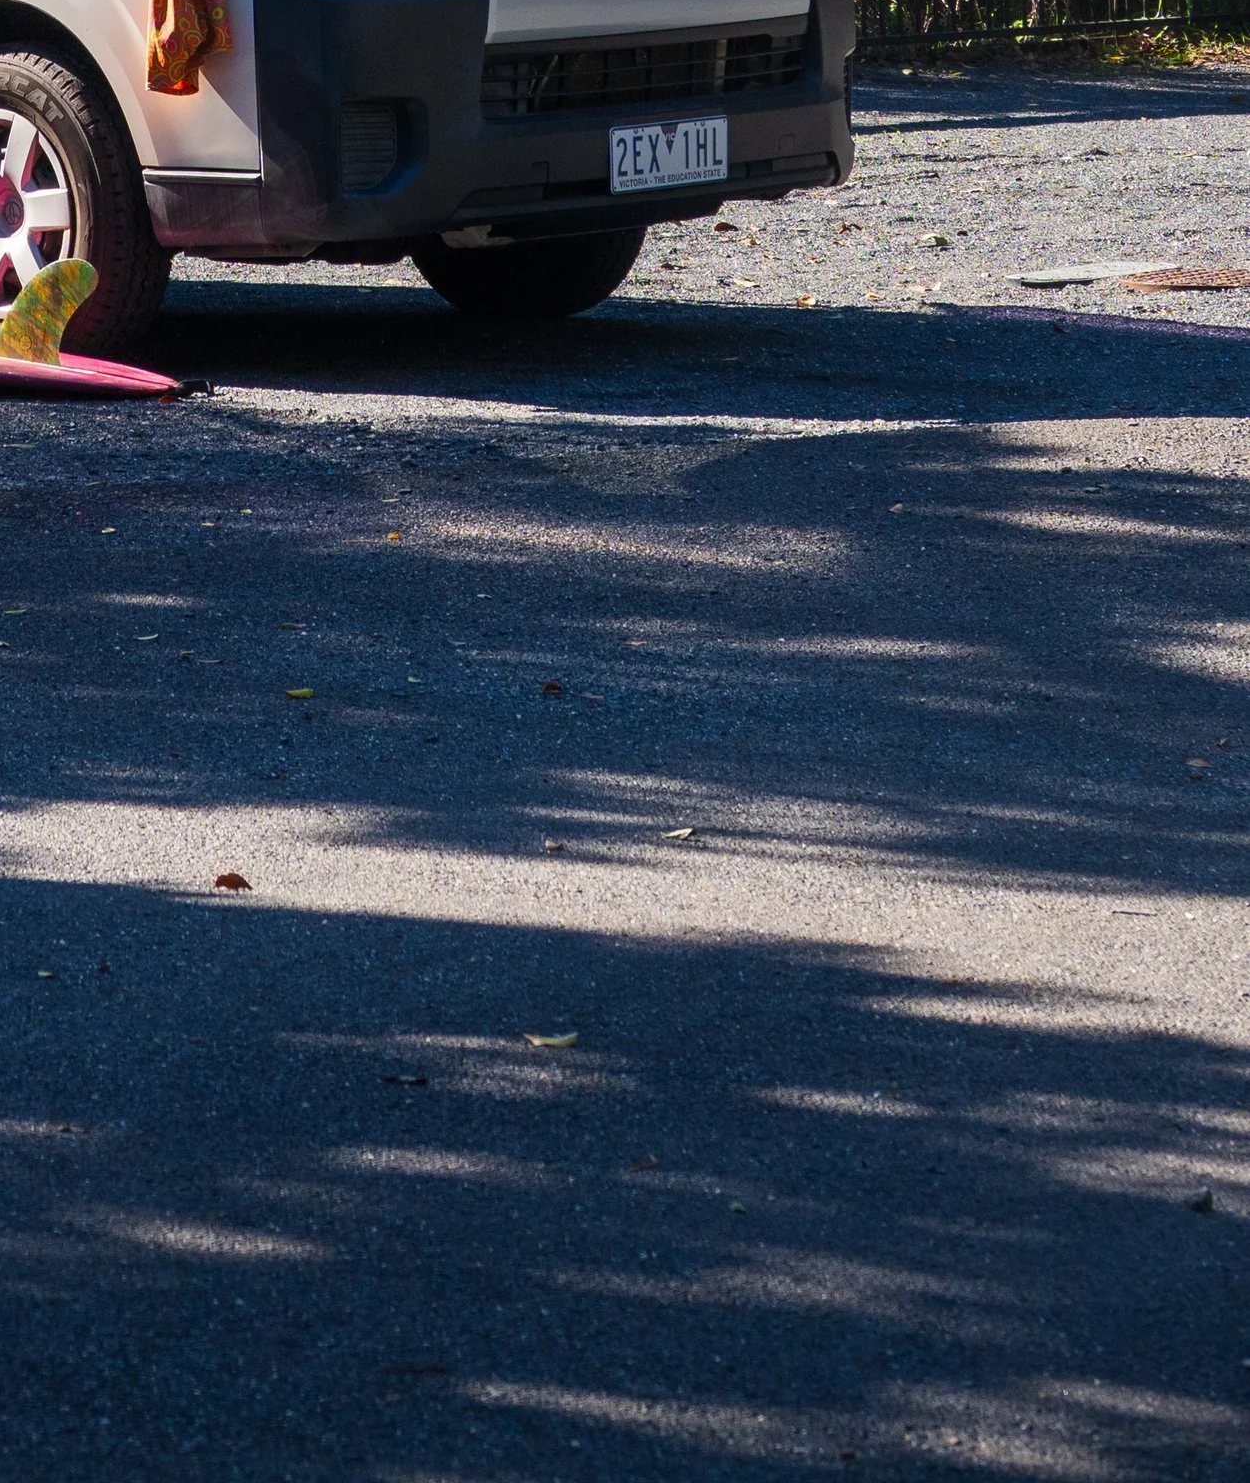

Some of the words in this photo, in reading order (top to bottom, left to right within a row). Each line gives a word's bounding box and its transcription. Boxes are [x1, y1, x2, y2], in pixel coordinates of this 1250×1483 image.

[616, 133, 661, 177] 2EX
[683, 127, 723, 170] 1HL
[619, 178, 649, 189] VICTORIA
[654, 176, 667, 184] THE
[667, 171, 702, 183] EDUCATION
[703, 168, 722, 178] STATE
